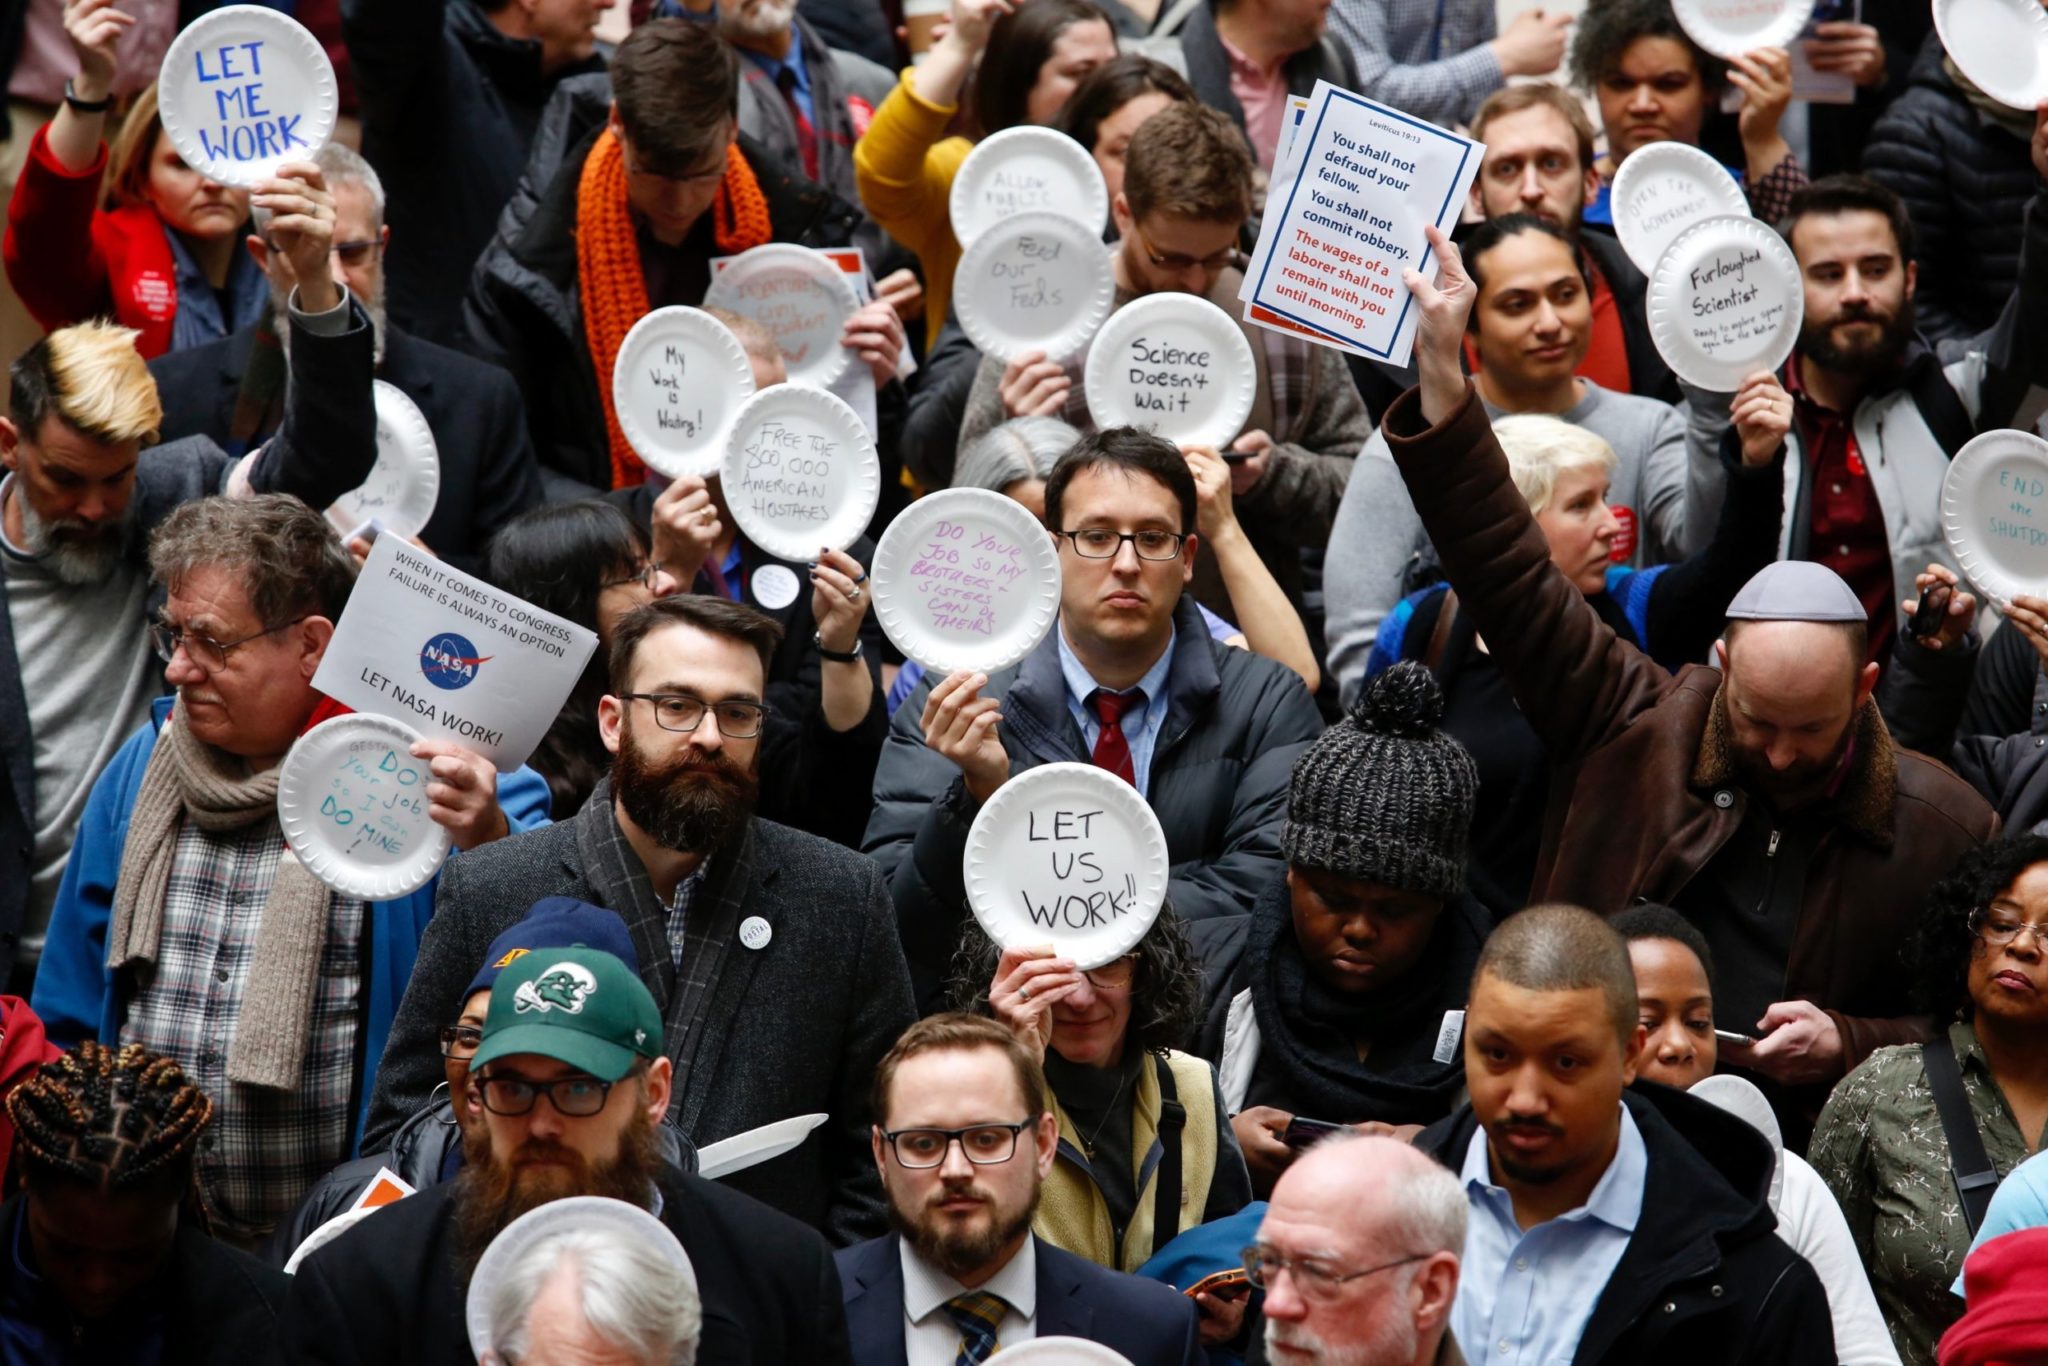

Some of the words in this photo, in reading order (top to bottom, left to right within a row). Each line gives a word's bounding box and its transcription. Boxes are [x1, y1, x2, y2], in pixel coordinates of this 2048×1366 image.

[196, 41, 264, 82] LET
[215, 83, 270, 121] ME
[199, 114, 309, 161] WORK
[1369, 118, 1400, 137] Leviticus
[1402, 130, 1422, 144] 19:13
[1332, 131, 1356, 151] You
[1357, 143, 1391, 164] shall
[1391, 159, 1416, 174] not
[1318, 167, 1360, 194] fellow.
[1324, 151, 1378, 180] defraud
[1377, 172, 1411, 193] your
[1310, 189, 1334, 209] You
[1336, 203, 1369, 222] shall
[1369, 217, 1393, 232] not
[1303, 210, 1353, 236] commit
[1354, 230, 1409, 260] robbery.
[1296, 229, 1320, 248] The
[1322, 241, 1363, 266] wages
[1365, 259, 1381, 273] of
[1380, 266, 1390, 277] a
[1690, 249, 1760, 290] Furloughed
[1288, 247, 1337, 275] laborer
[1338, 269, 1370, 289] shall
[1371, 283, 1395, 299] not
[1276, 283, 1308, 304] until
[1308, 299, 1366, 329] morning.
[1282, 266, 1328, 292] remain
[1331, 285, 1359, 305] with
[1360, 299, 1386, 316] you
[1692, 284, 1758, 316] Scientist
[666, 345, 685, 376] My
[1131, 337, 1210, 368] Science
[649, 367, 680, 390] Work
[1130, 368, 1209, 390] Doesn't
[1135, 392, 1191, 413] Wait
[761, 422, 802, 450] FREE
[807, 434, 841, 457] THE
[745, 443, 829, 477] 800,000
[742, 470, 826, 498] AMERICAN
[2000, 470, 2044, 496] END
[752, 498, 830, 521] HOSTAGES
[936, 521, 964, 540] DO
[919, 543, 959, 563] JOB
[972, 557, 991, 571] SO
[910, 559, 994, 590] BROTHERS
[396, 551, 430, 577] WHEN
[434, 570, 446, 583] IT
[446, 578, 487, 605] COMES
[490, 598, 508, 613] TO
[508, 608, 573, 645] CONGRESS,
[918, 580, 993, 605] SISTERS
[927, 597, 969, 613] CAN
[389, 567, 435, 598] FAILURE
[436, 592, 447, 605] IS
[448, 600, 499, 630] ALWAYS
[499, 623, 518, 639] AN
[519, 632, 565, 658] OPTION
[425, 645, 472, 678] NASA
[360, 667, 391, 692] LET
[392, 686, 436, 720] NASA
[442, 711, 503, 747] WORK!
[378, 750, 418, 786] DO
[320, 795, 353, 825] DO
[356, 823, 404, 855] MINE
[1029, 810, 1104, 841] LET
[1053, 851, 1103, 883] US
[1022, 873, 1137, 928] WORK!!
